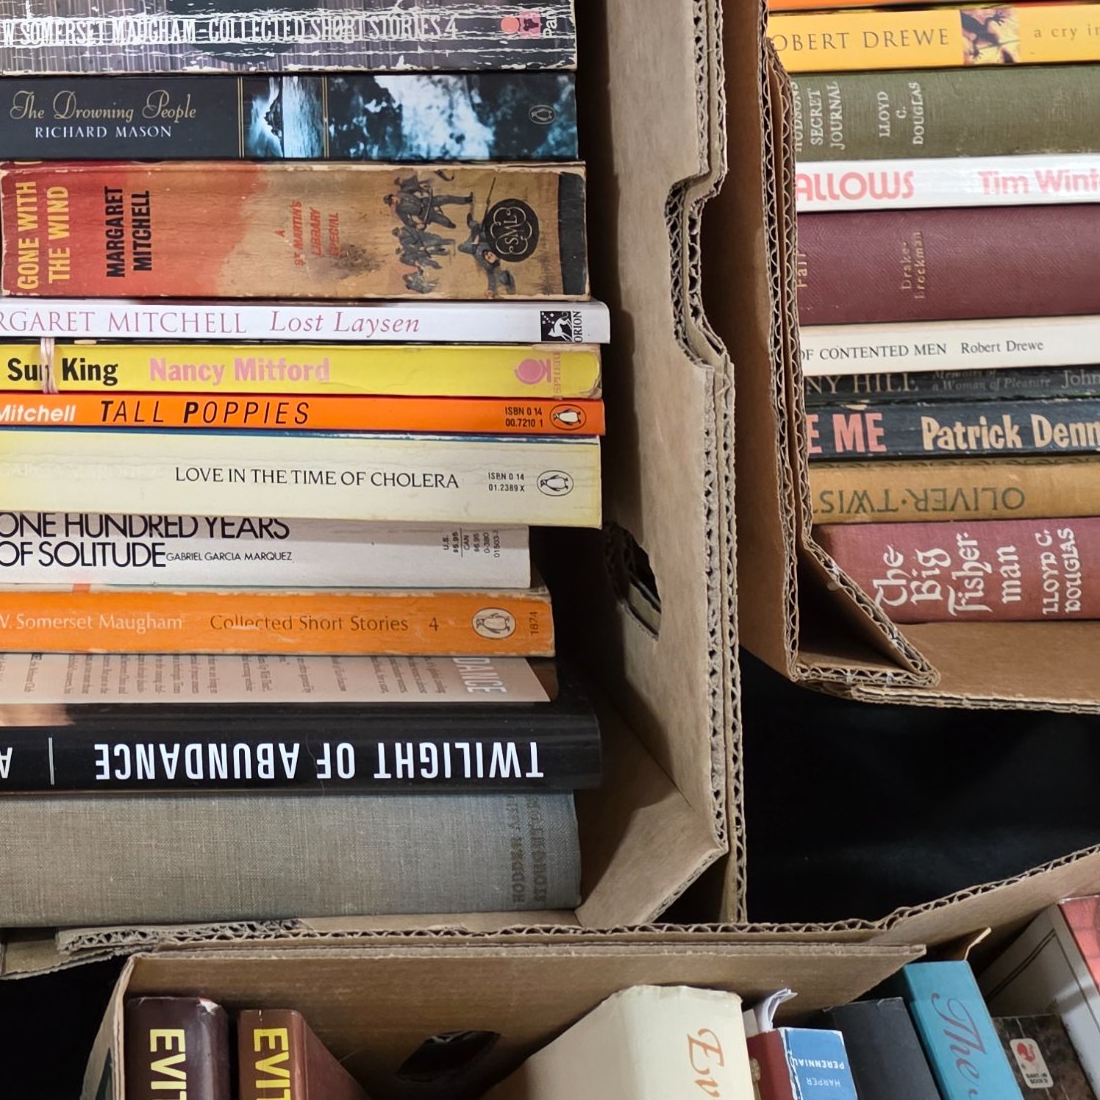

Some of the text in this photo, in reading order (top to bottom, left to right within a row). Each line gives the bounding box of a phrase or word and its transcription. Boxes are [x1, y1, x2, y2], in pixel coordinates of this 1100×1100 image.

[34, 125, 172, 140] RICHARD MASON
[809, 87, 825, 147] SECRET
[877, 90, 891, 138] LLOYD
[910, 81, 926, 146] DOUGLAS
[978, 169, 1030, 198] Tim
[15, 180, 41, 290] GONE WITH
[46, 186, 71, 285] THE WIND
[103, 185, 126, 278] MARGARET
[131, 190, 153, 272] MITCHELL
[107, 310, 247, 336] MITCHELL
[268, 311, 324, 335] Lost
[333, 310, 421, 340] Laysen
[573, 310, 583, 343] ORION
[819, 338, 1045, 361] CONTENTED MEN Robert Drewe
[7, 357, 50, 382] Sun
[61, 357, 119, 387] King
[149, 358, 225, 388] Nancy
[233, 356, 331, 384] Mitford
[100, 400, 165, 424] TALL
[182, 400, 311, 426] POPPIES
[832, 412, 1023, 453] ME Patrick
[175, 466, 460, 490] LOVE IN THE TIME OF CHOLERA
[38, 541, 167, 569] SOLITUDE
[166, 551, 204, 563] GABRIEL
[204, 551, 242, 563] GARCIA
[244, 551, 293, 564] MARQUEZ
[15, 613, 96, 631] Somerset
[99, 613, 184, 635] Maugham
[209, 614, 293, 633] Collected
[298, 614, 344, 633] Short
[349, 614, 410, 633] Stories
[427, 615, 441, 633] 4
[92, 742, 301, 781] ABUNDANCE
[316, 742, 356, 780] OF
[372, 741, 545, 780] TWILIGHT
